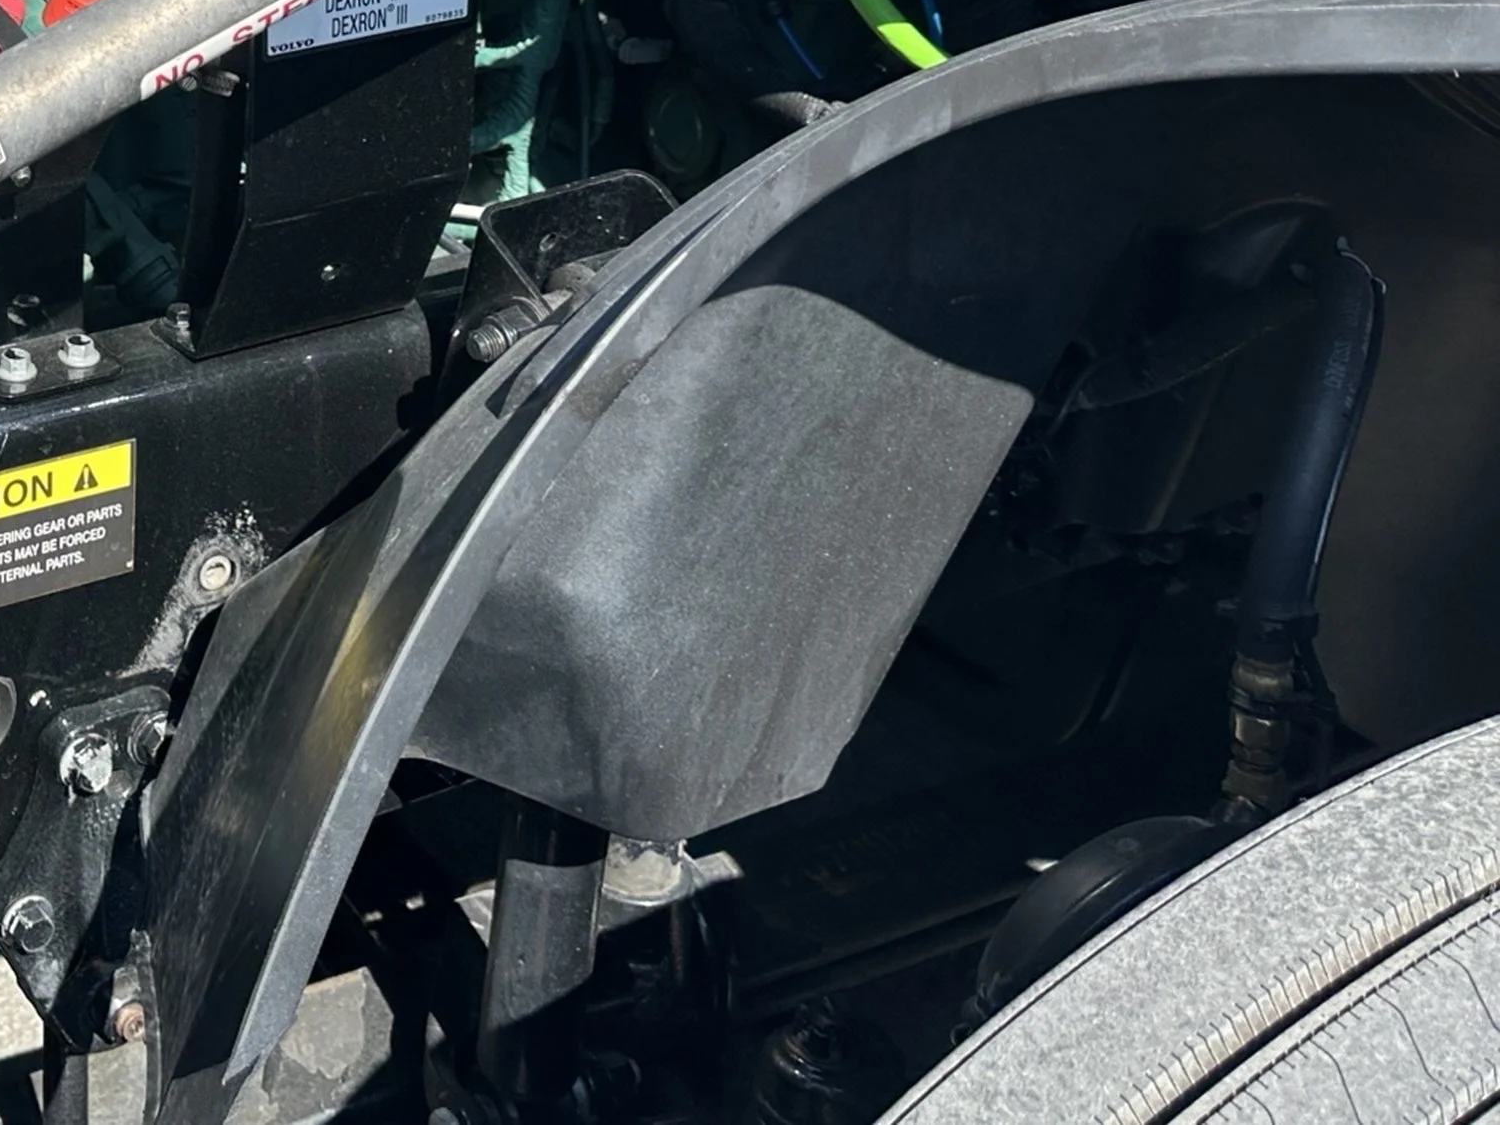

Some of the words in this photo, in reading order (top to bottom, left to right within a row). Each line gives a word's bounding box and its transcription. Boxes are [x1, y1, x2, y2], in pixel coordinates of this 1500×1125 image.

[396, 4, 408, 25] III
[269, 37, 315, 55] VOLVO
[33, 518, 66, 539] GEAR
[67, 513, 85, 527] OR
[86, 503, 123, 523] PARTS
[14, 543, 40, 561] MAY
[41, 538, 58, 554] BE
[59, 527, 106, 549] FORCED
[46, 550, 85, 571] PARTS.
